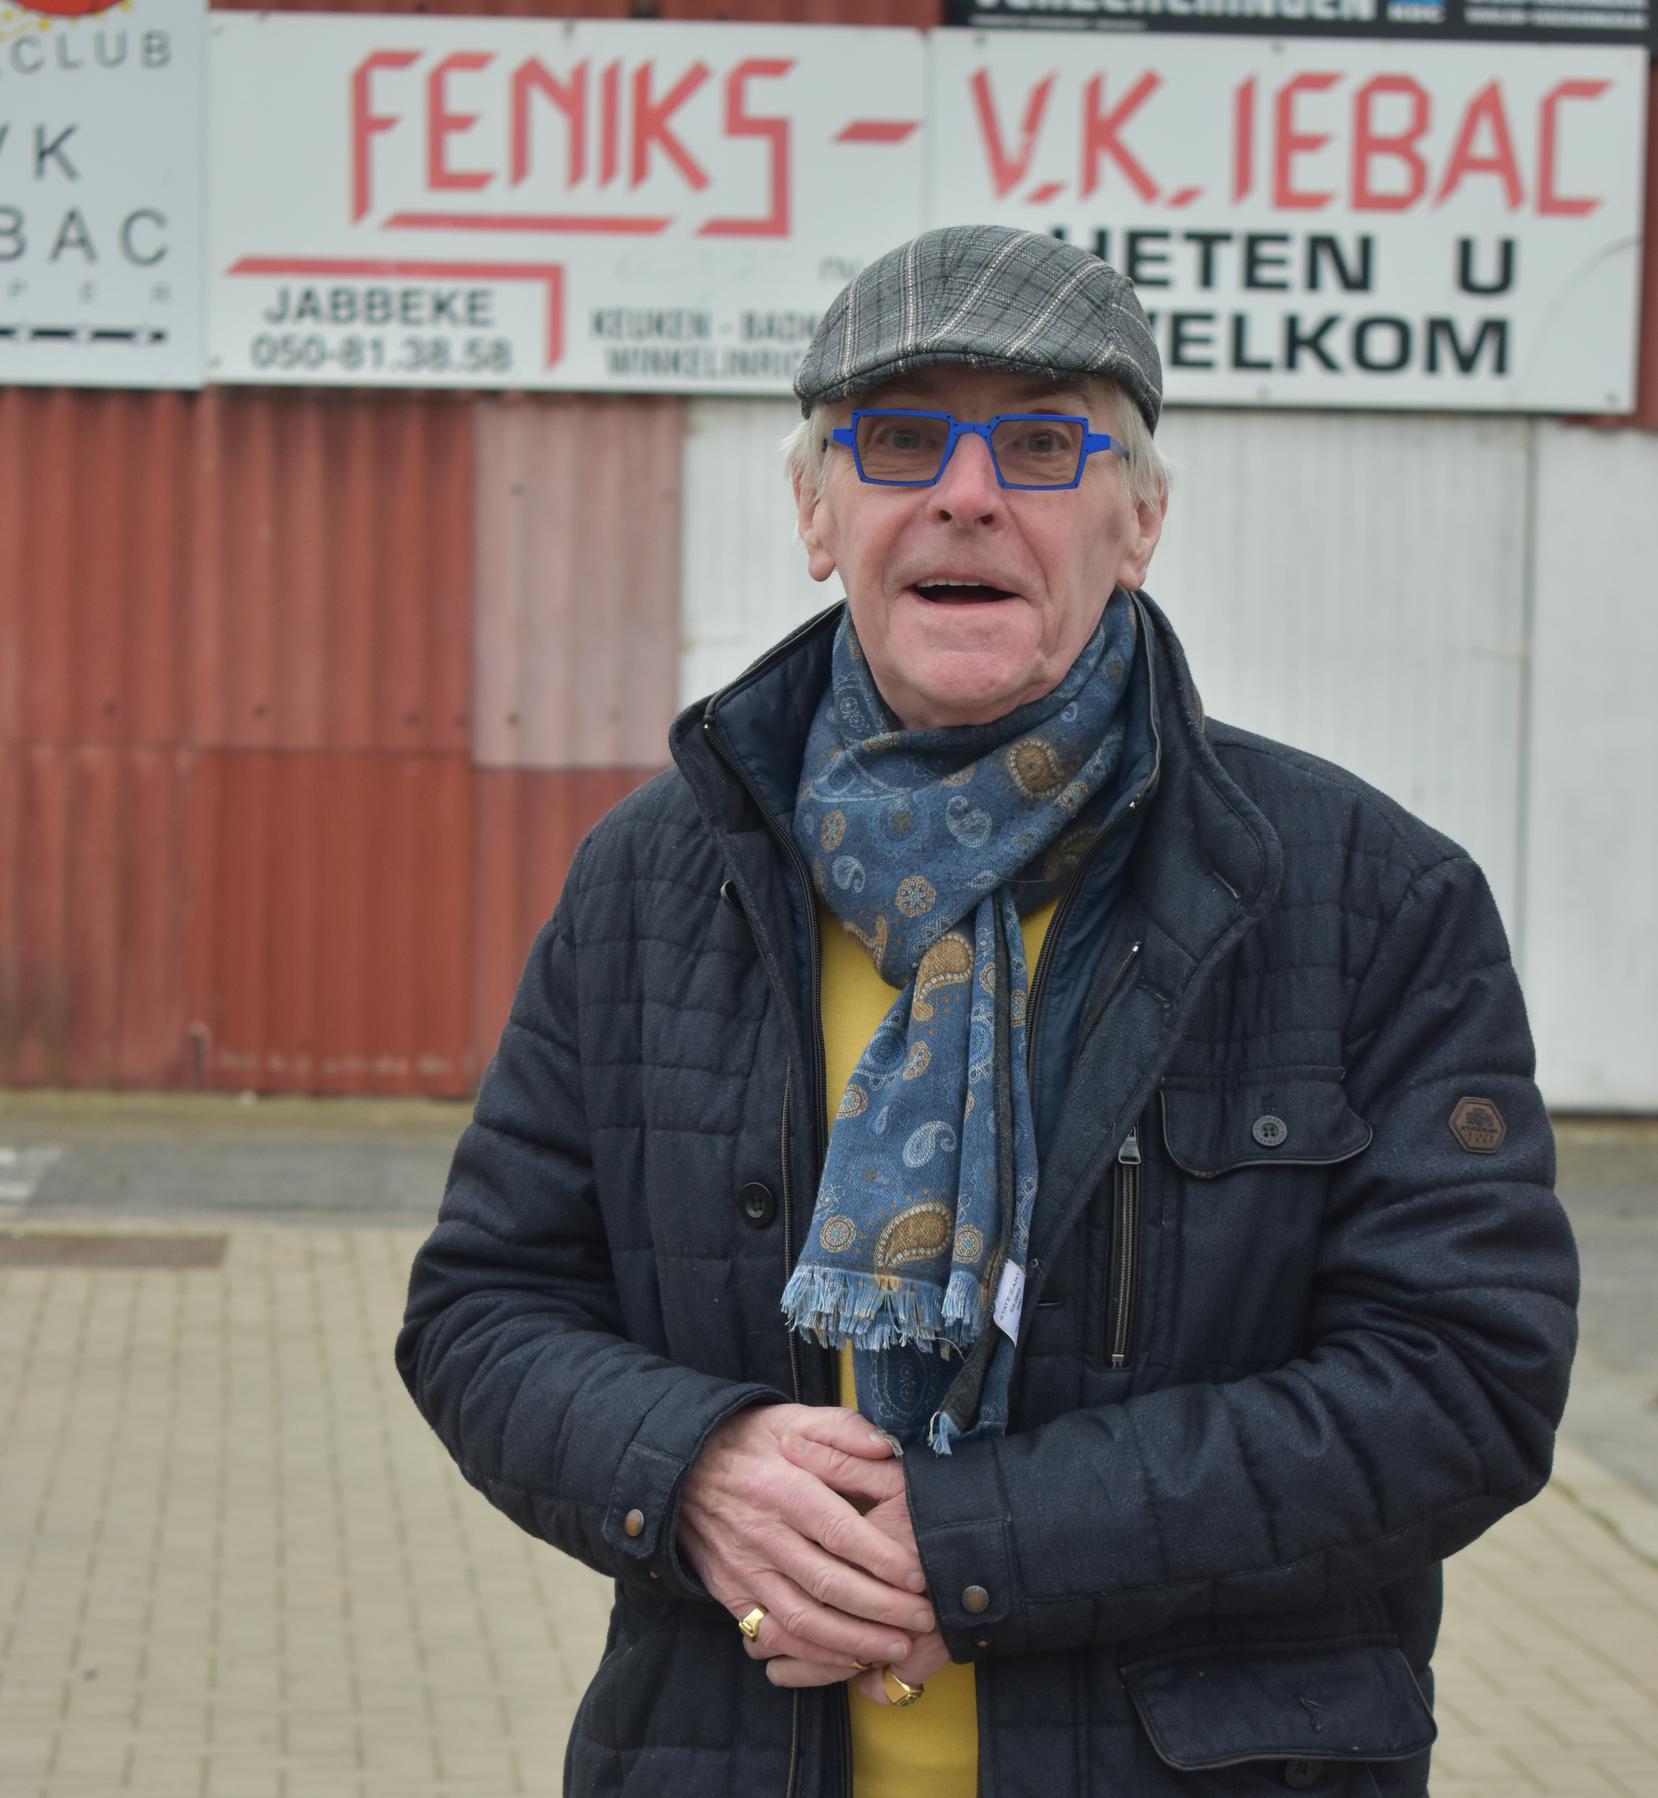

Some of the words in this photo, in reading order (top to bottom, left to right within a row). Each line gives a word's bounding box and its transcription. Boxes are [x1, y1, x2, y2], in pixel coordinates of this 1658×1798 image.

[9, 30, 172, 75] CLUB
[351, 50, 796, 238] FENIKS
[1230, 72, 1616, 217] IEBAC
[1457, 236, 1516, 295] U
[263, 286, 495, 328] JABBEKE
[591, 307, 710, 339] KEUKEN
[250, 334, 513, 373] 050-81.38.58
[1146, 309, 1511, 375] ELKOM
